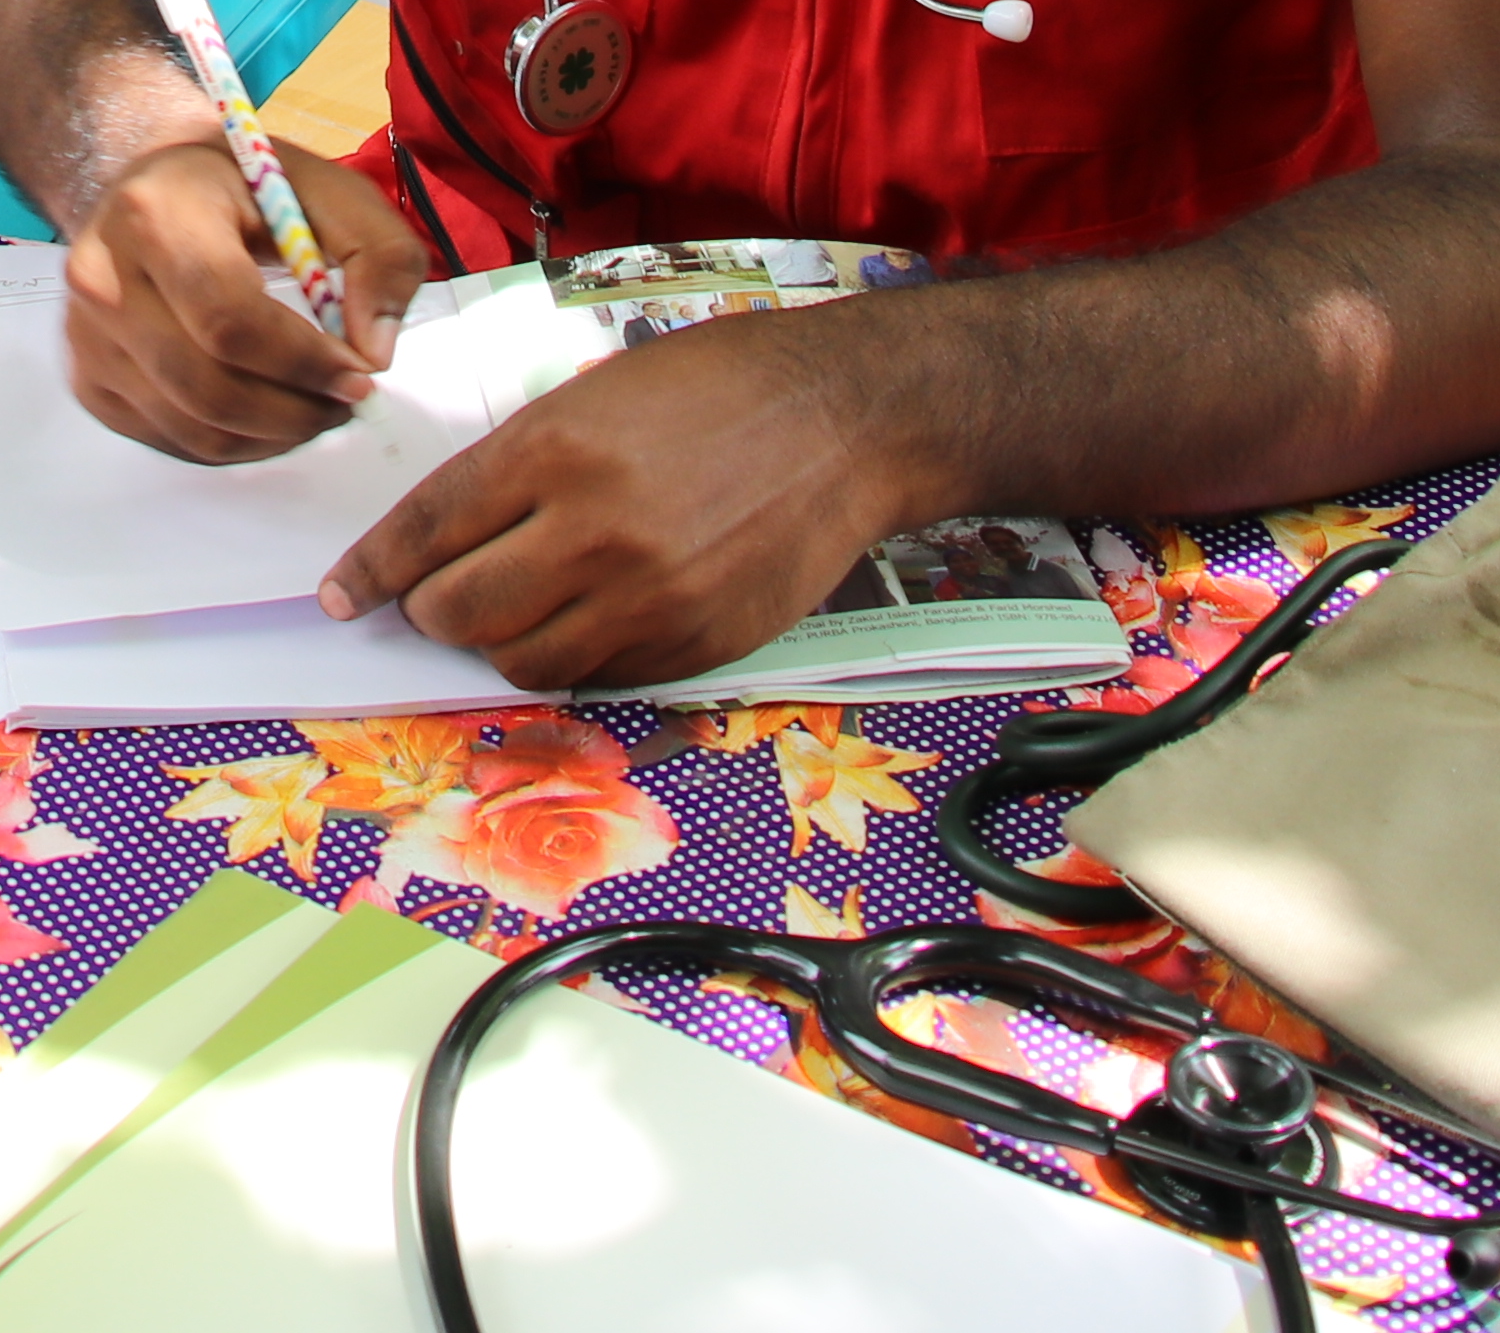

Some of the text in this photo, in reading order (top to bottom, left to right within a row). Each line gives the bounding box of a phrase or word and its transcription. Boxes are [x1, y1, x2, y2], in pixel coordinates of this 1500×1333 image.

[887, 609, 921, 620] Islam
[922, 605, 973, 617] Faruque
[988, 603, 1020, 612] Farid
[1022, 603, 1073, 612] Morshed
[807, 629, 850, 640] PURBA
[924, 614, 995, 626] Bangladesh
